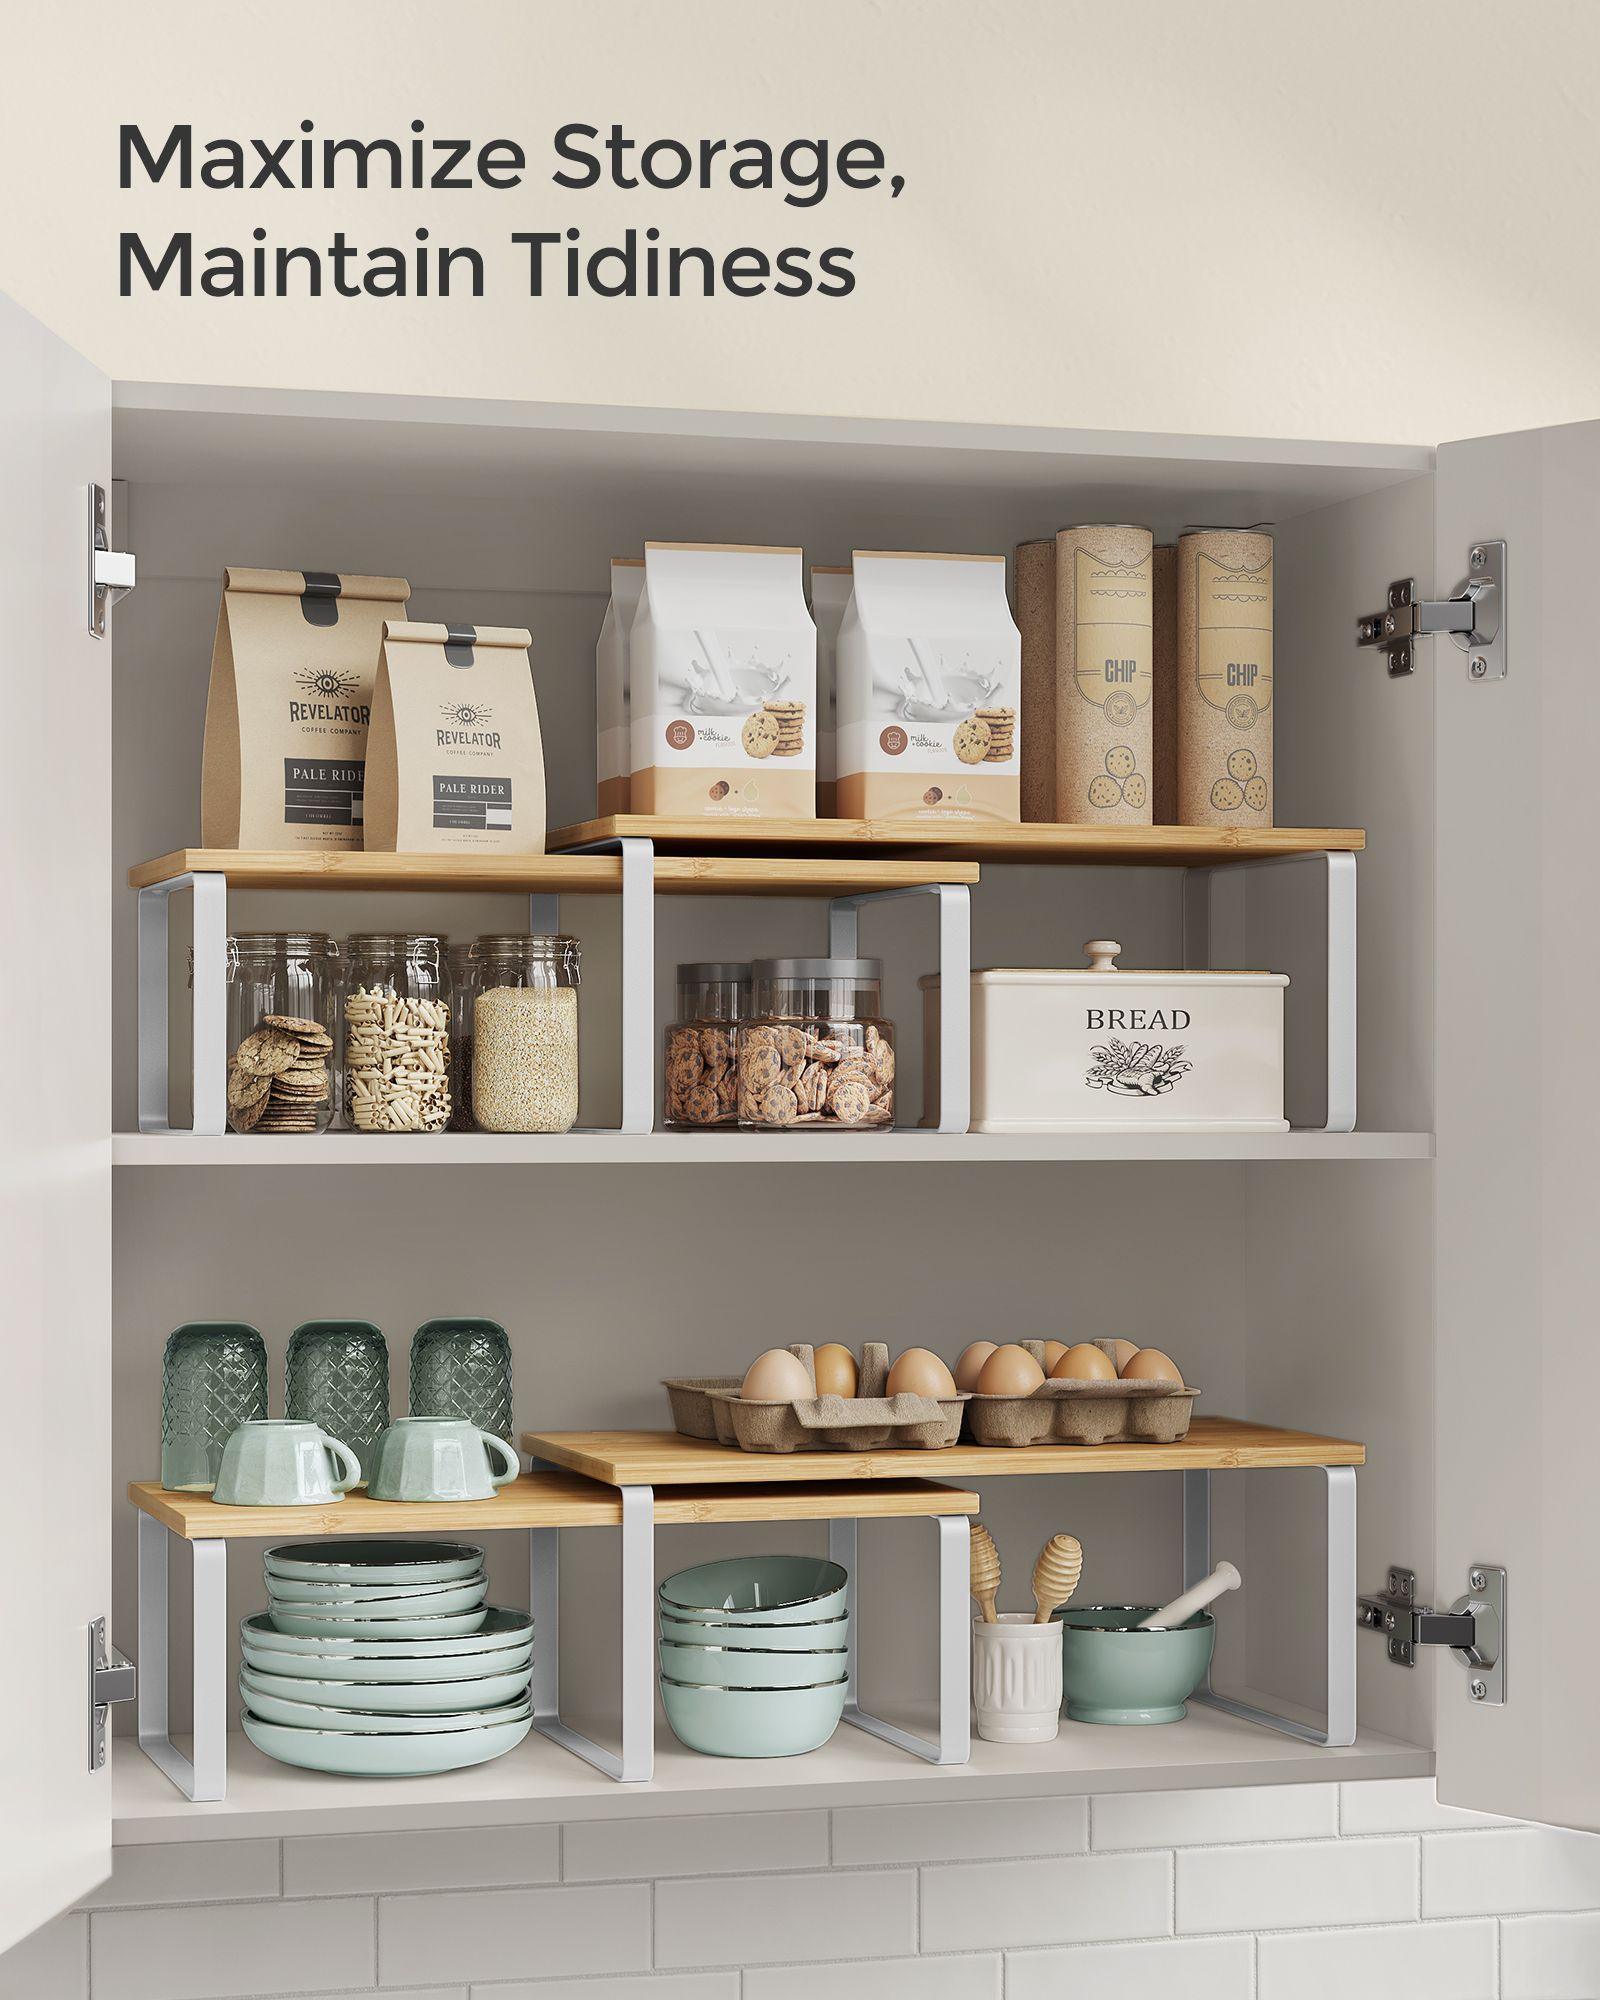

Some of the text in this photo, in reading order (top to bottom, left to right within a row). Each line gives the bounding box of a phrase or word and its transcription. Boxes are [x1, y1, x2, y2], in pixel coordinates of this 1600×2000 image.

[1104, 659, 1136, 683] CHIP
[1226, 663, 1258, 686] CHIP
[289, 701, 371, 726] REVELATOR
[301, 726, 362, 736] COFFEE COMPANY
[436, 729, 502, 750] REVELATOR
[292, 767, 365, 781] PALE RIDE
[439, 783, 505, 795] PALE RIDER
[1086, 1009, 1191, 1030] BREAD
